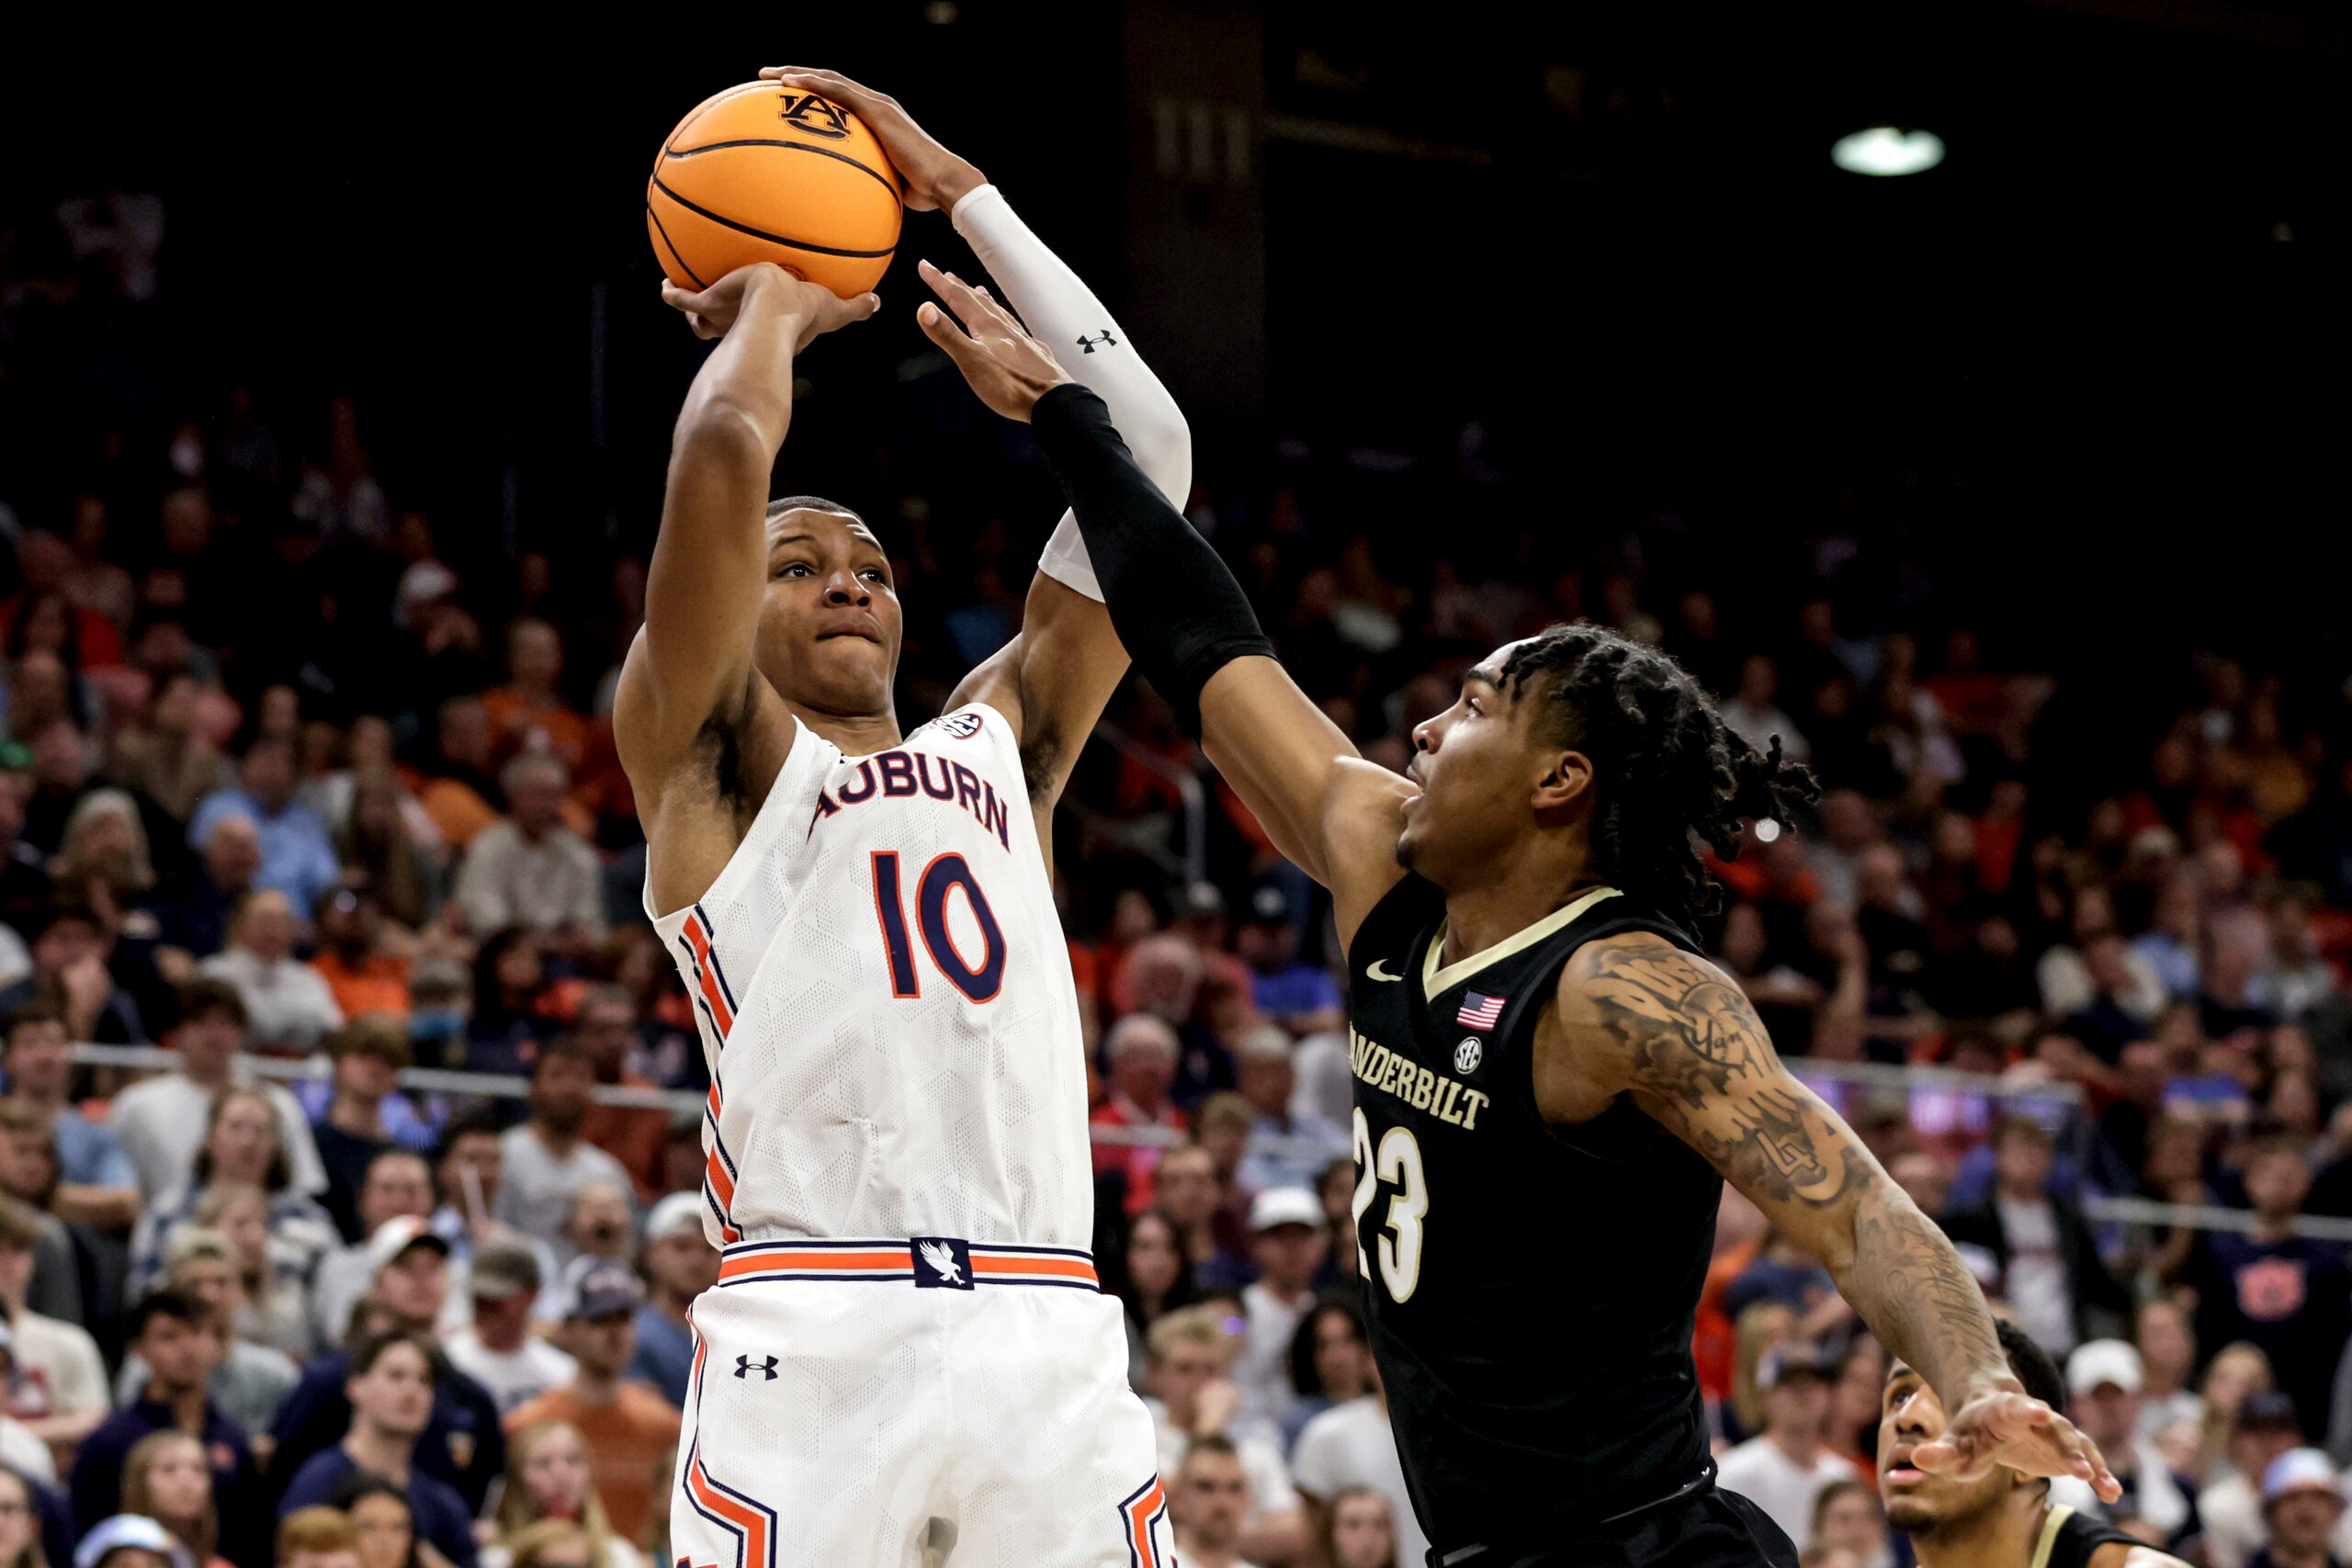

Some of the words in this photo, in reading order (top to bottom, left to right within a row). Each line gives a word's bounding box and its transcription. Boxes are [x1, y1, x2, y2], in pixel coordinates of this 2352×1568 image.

[806, 750, 1010, 853] AUBURN
[870, 851, 1007, 1004] 10
[1349, 1021, 1490, 1131] ANDERBILT
[1456, 1040, 1480, 1070] SEC
[1351, 1106, 1429, 1303] 23
